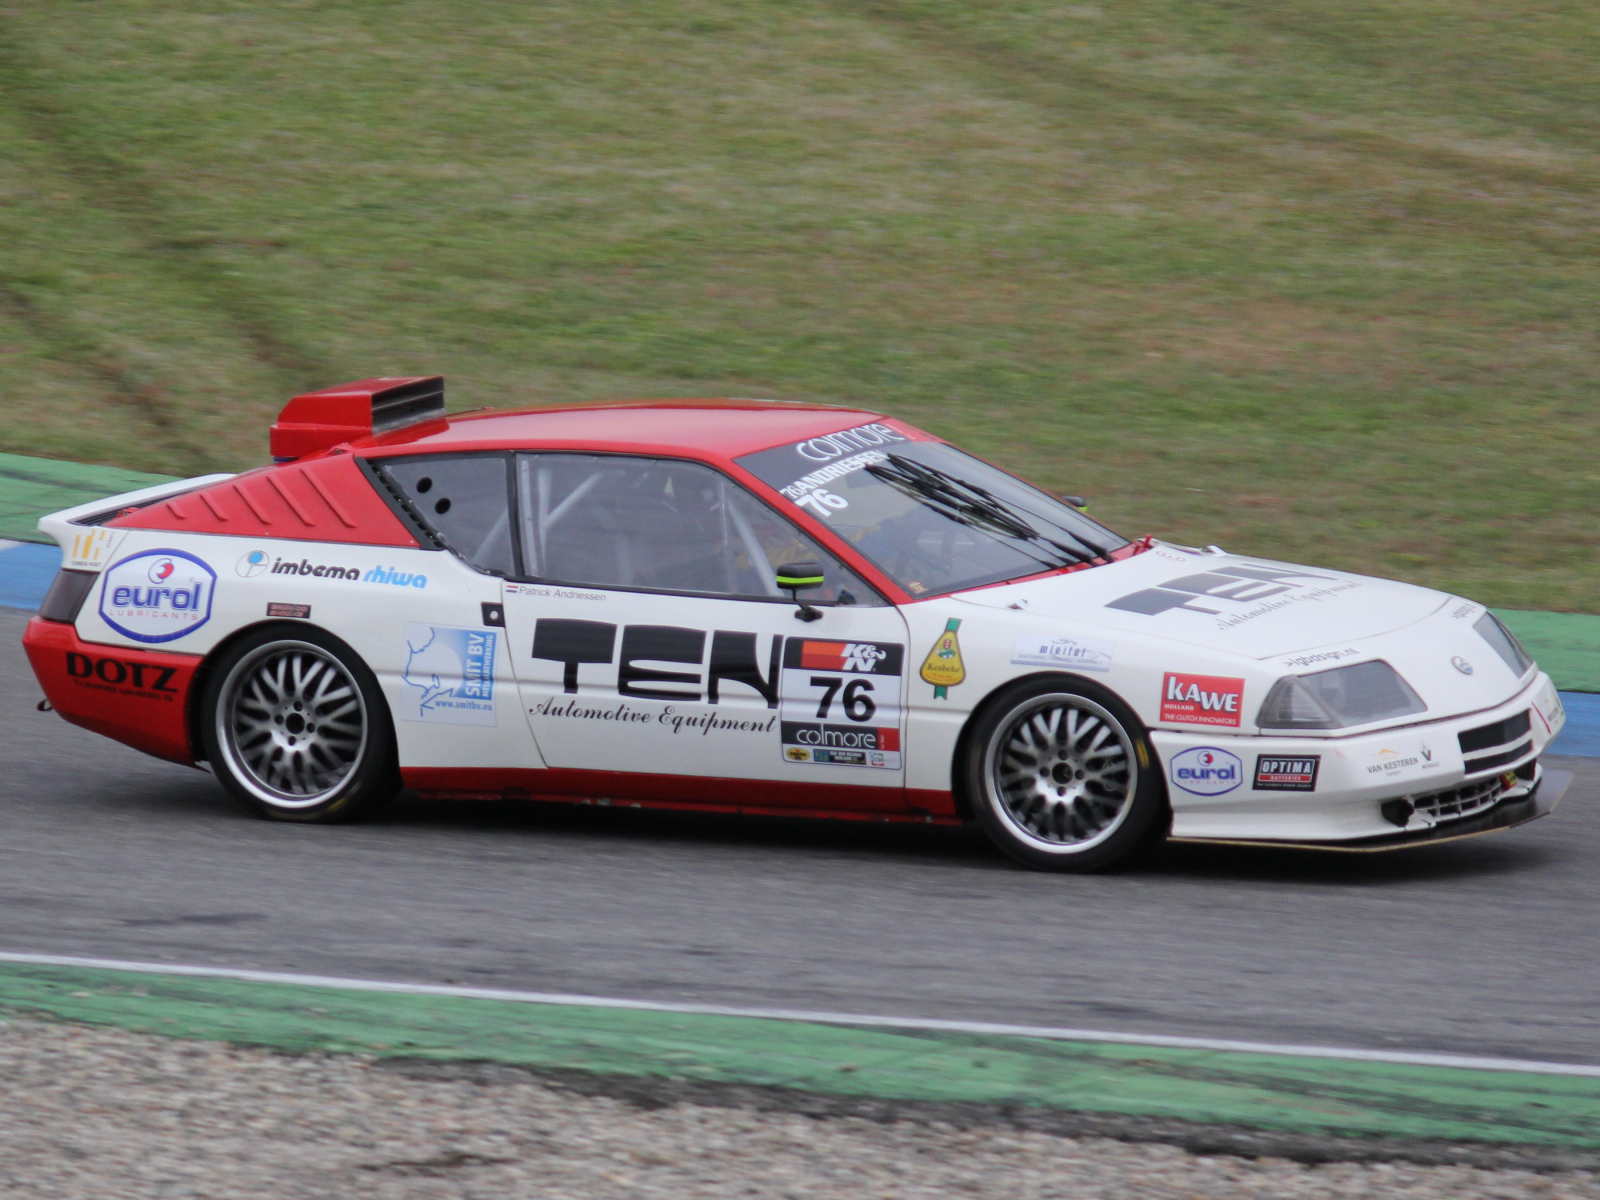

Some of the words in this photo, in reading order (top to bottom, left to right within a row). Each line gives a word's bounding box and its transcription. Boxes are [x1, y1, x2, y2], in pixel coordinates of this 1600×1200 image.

[796, 423, 905, 461] colmore
[794, 488, 848, 516] 76
[270, 556, 360, 581] imbema
[363, 565, 427, 589] rhiwa
[112, 581, 203, 611] eurol
[519, 586, 551, 598] Patrick
[553, 589, 606, 601] Andriessen
[1103, 563, 1339, 616] TEN
[109, 609, 198, 621] LUBRICANTS
[467, 633, 485, 655] BV
[841, 643, 887, 672] K&N
[66, 652, 178, 692] DOTZ
[531, 618, 784, 709] TEN
[927, 662, 960, 673] Kesbeke
[465, 659, 482, 697] SMIT
[435, 700, 493, 711] www.smitbv.eu
[810, 676, 877, 722] 76
[1164, 703, 1194, 711] HOLLAND
[528, 697, 653, 724] Automotive
[658, 705, 776, 736] Equipment
[1198, 716, 1237, 725] INNOVATORS
[796, 723, 877, 749] colmore
[1177, 764, 1235, 780] eurol
[1262, 761, 1311, 773] OPTIMA
[1366, 763, 1383, 773] VAN
[1383, 756, 1419, 771] KESTEREN
